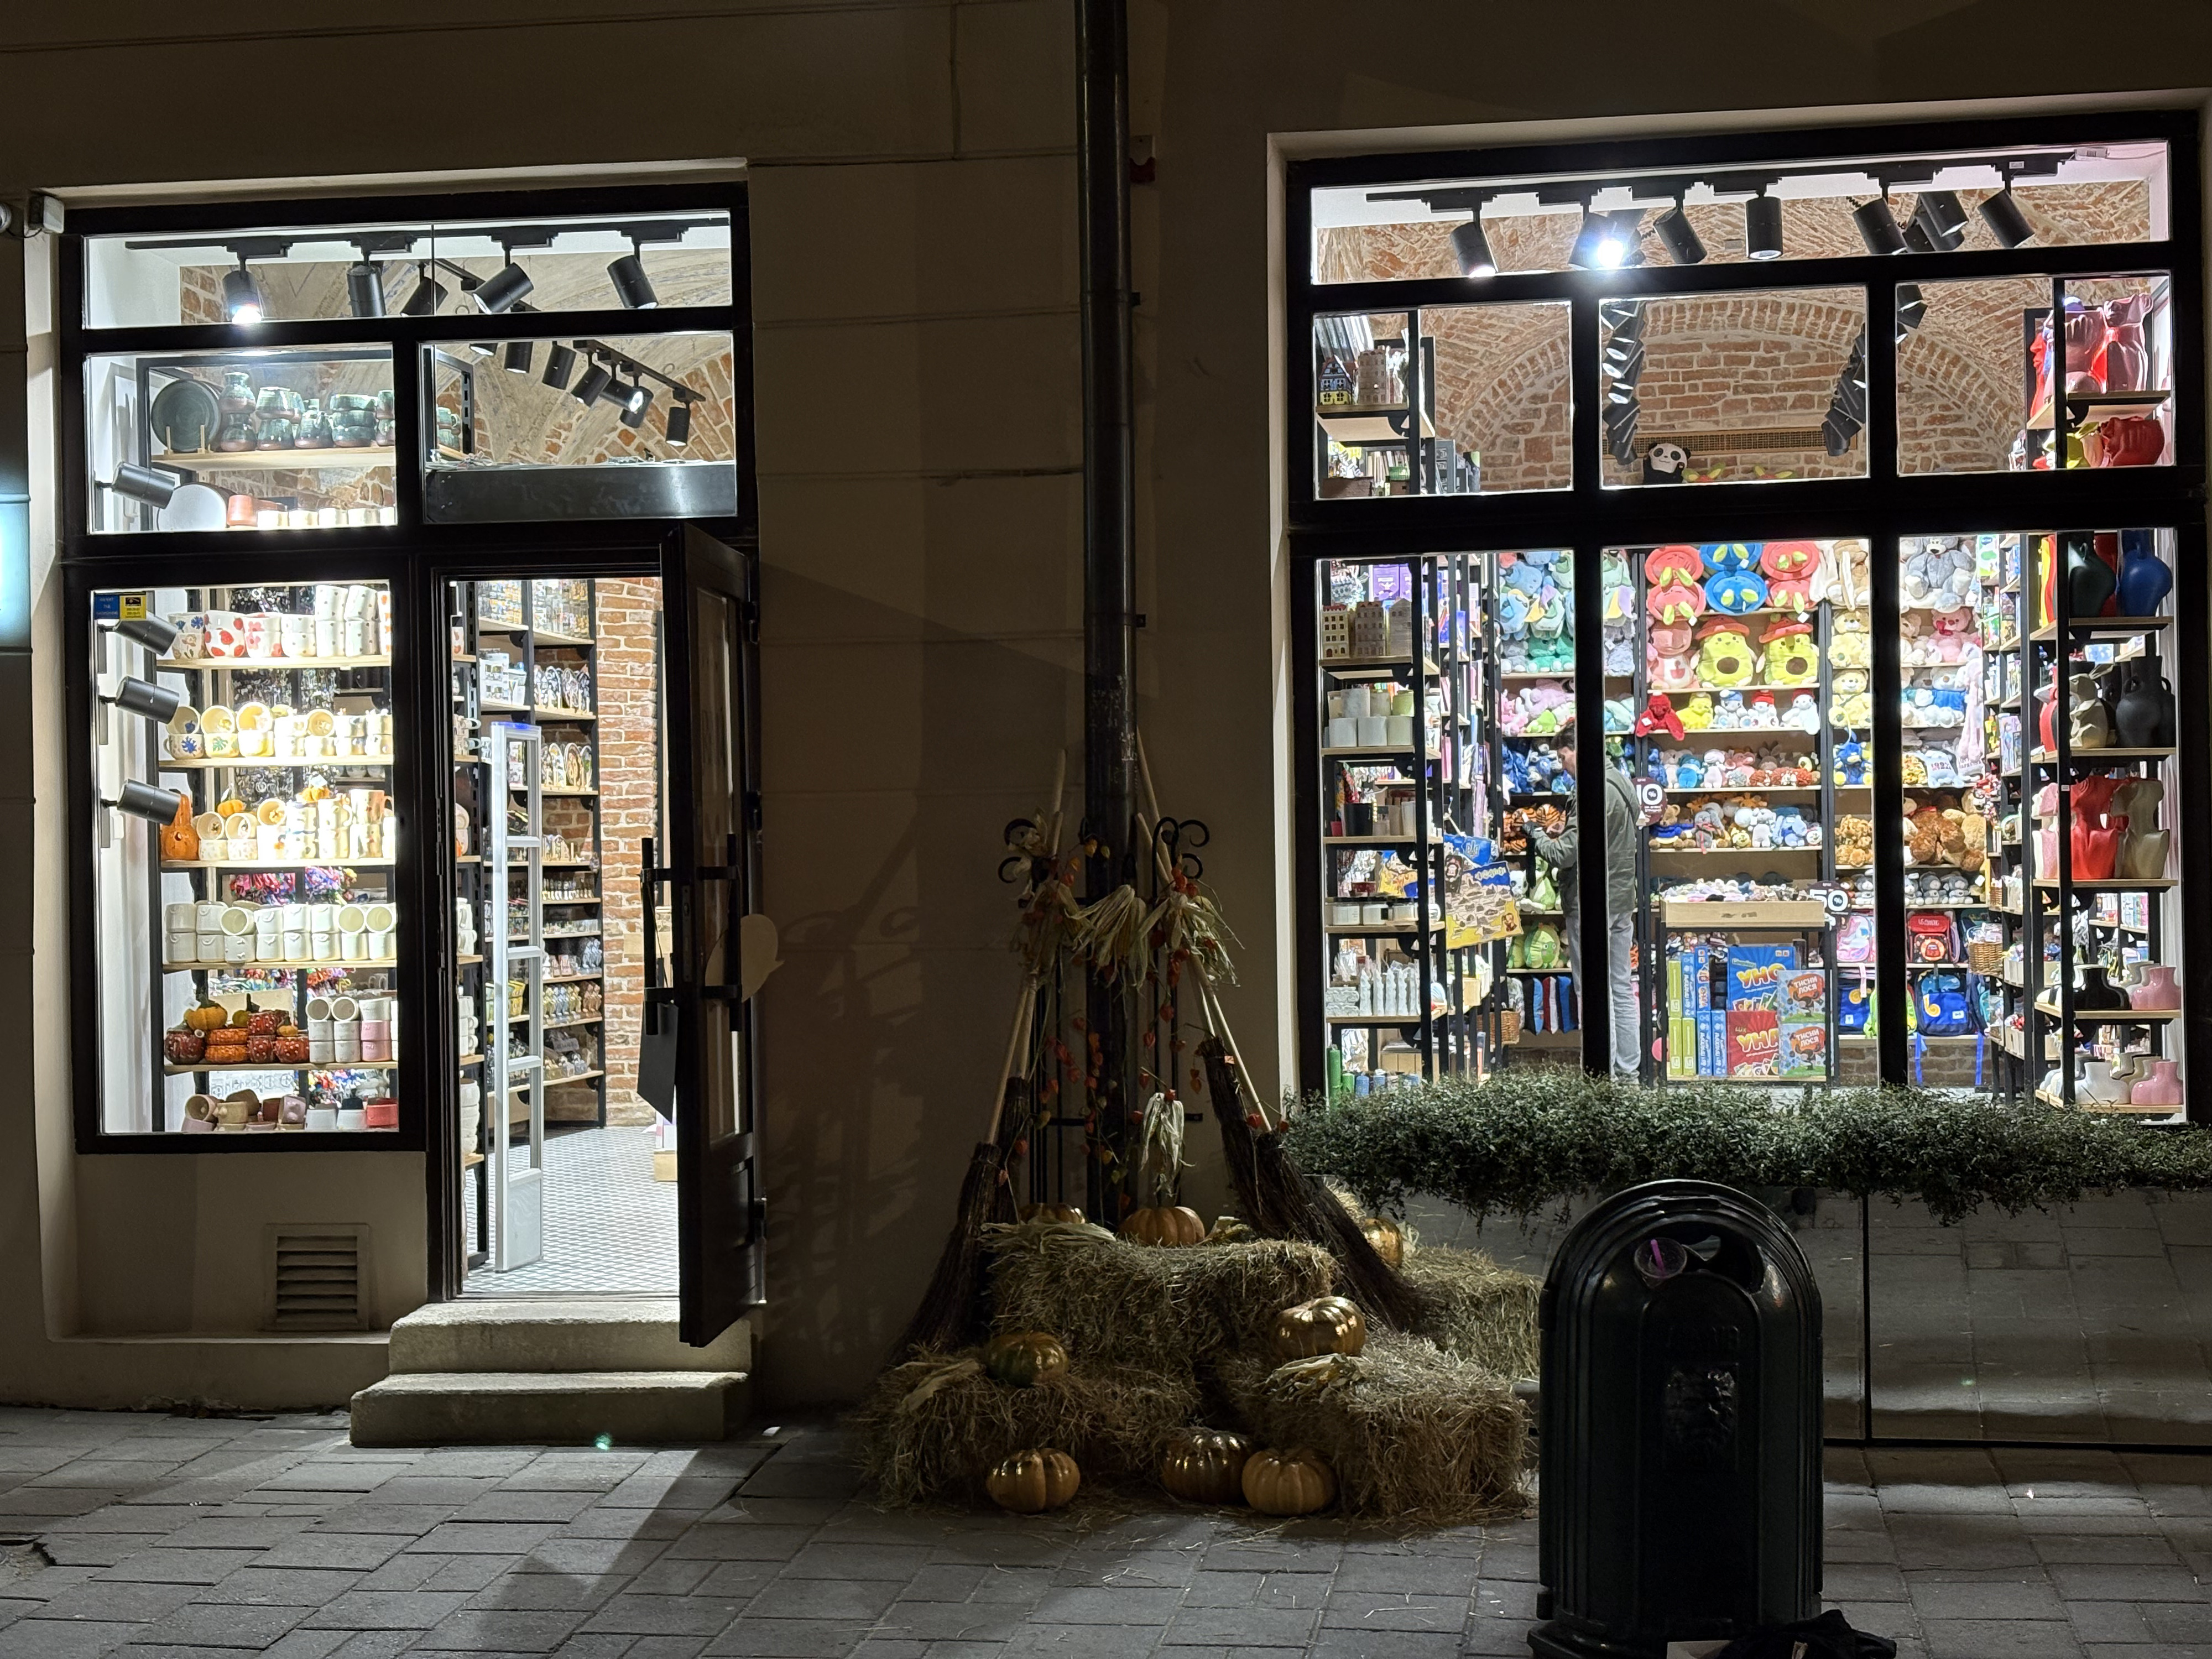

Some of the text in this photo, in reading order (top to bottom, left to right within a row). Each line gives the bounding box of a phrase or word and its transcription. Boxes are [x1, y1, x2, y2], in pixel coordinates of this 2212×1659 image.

[1793, 975, 1818, 988] ТИСНИ
[1798, 983, 1817, 994] ЛОСЯ
[1796, 1029, 1819, 1041] ТИСНИ
[1800, 1036, 1819, 1047] ЛОСЯ
